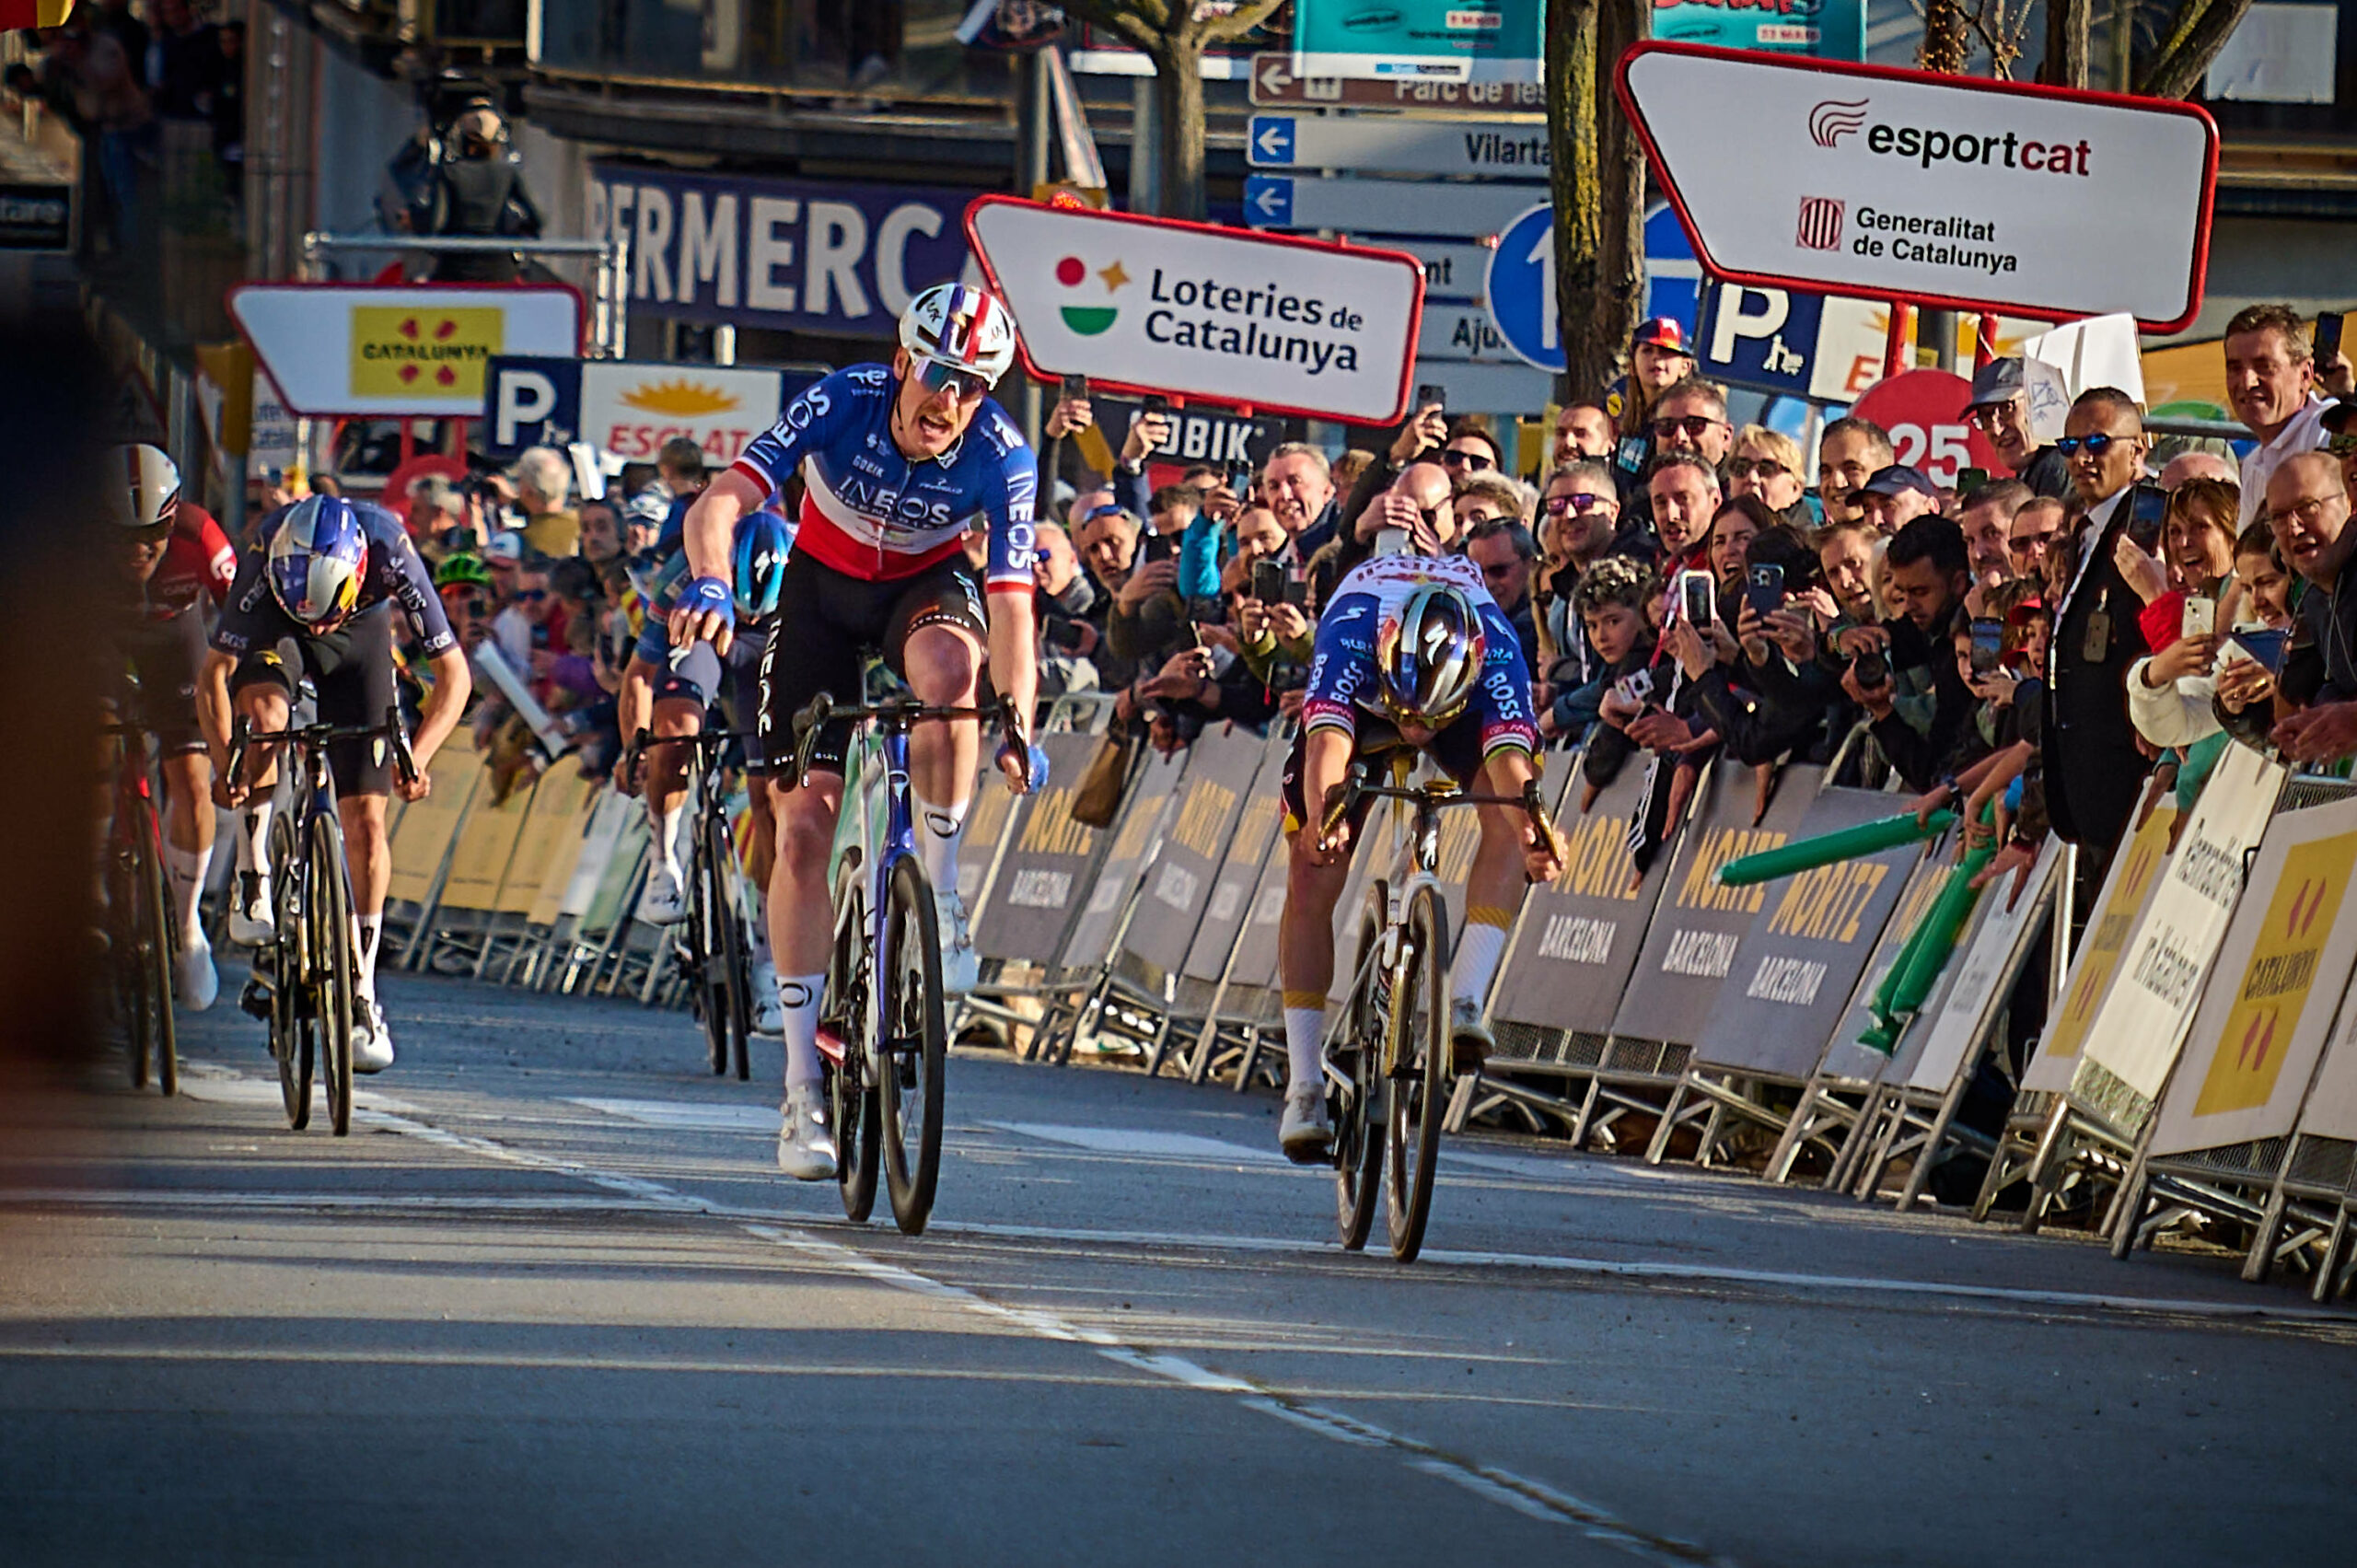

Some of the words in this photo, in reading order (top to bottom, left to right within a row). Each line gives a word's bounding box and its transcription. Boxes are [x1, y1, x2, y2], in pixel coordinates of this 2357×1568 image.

[1394, 80, 1459, 103] Parc
[1867, 123, 2092, 177] esportcat
[585, 180, 993, 319] PERMERC
[1856, 206, 1995, 242] Generalitat
[1852, 234, 1884, 257] de
[1891, 238, 2018, 275] Catalunya
[1151, 268, 1325, 325] Loteries
[1329, 306, 1364, 331] de
[1709, 280, 1789, 364] P
[362, 343, 490, 363] CATALUNYA
[1144, 309, 1359, 376] Catalunya
[1451, 317, 1506, 354] Aju
[495, 369, 558, 446] P
[749, 386, 830, 466] INEOS
[608, 424, 750, 460] ESCAT
[1130, 409, 1254, 462] OBIK
[1888, 423, 1972, 489] 25
[840, 475, 951, 525] INEOS
[1006, 470, 1035, 571] INEOS
[1329, 660, 1364, 705] BOSS
[1483, 671, 1523, 721] BOSS
[1766, 860, 1889, 943] MORITZ
